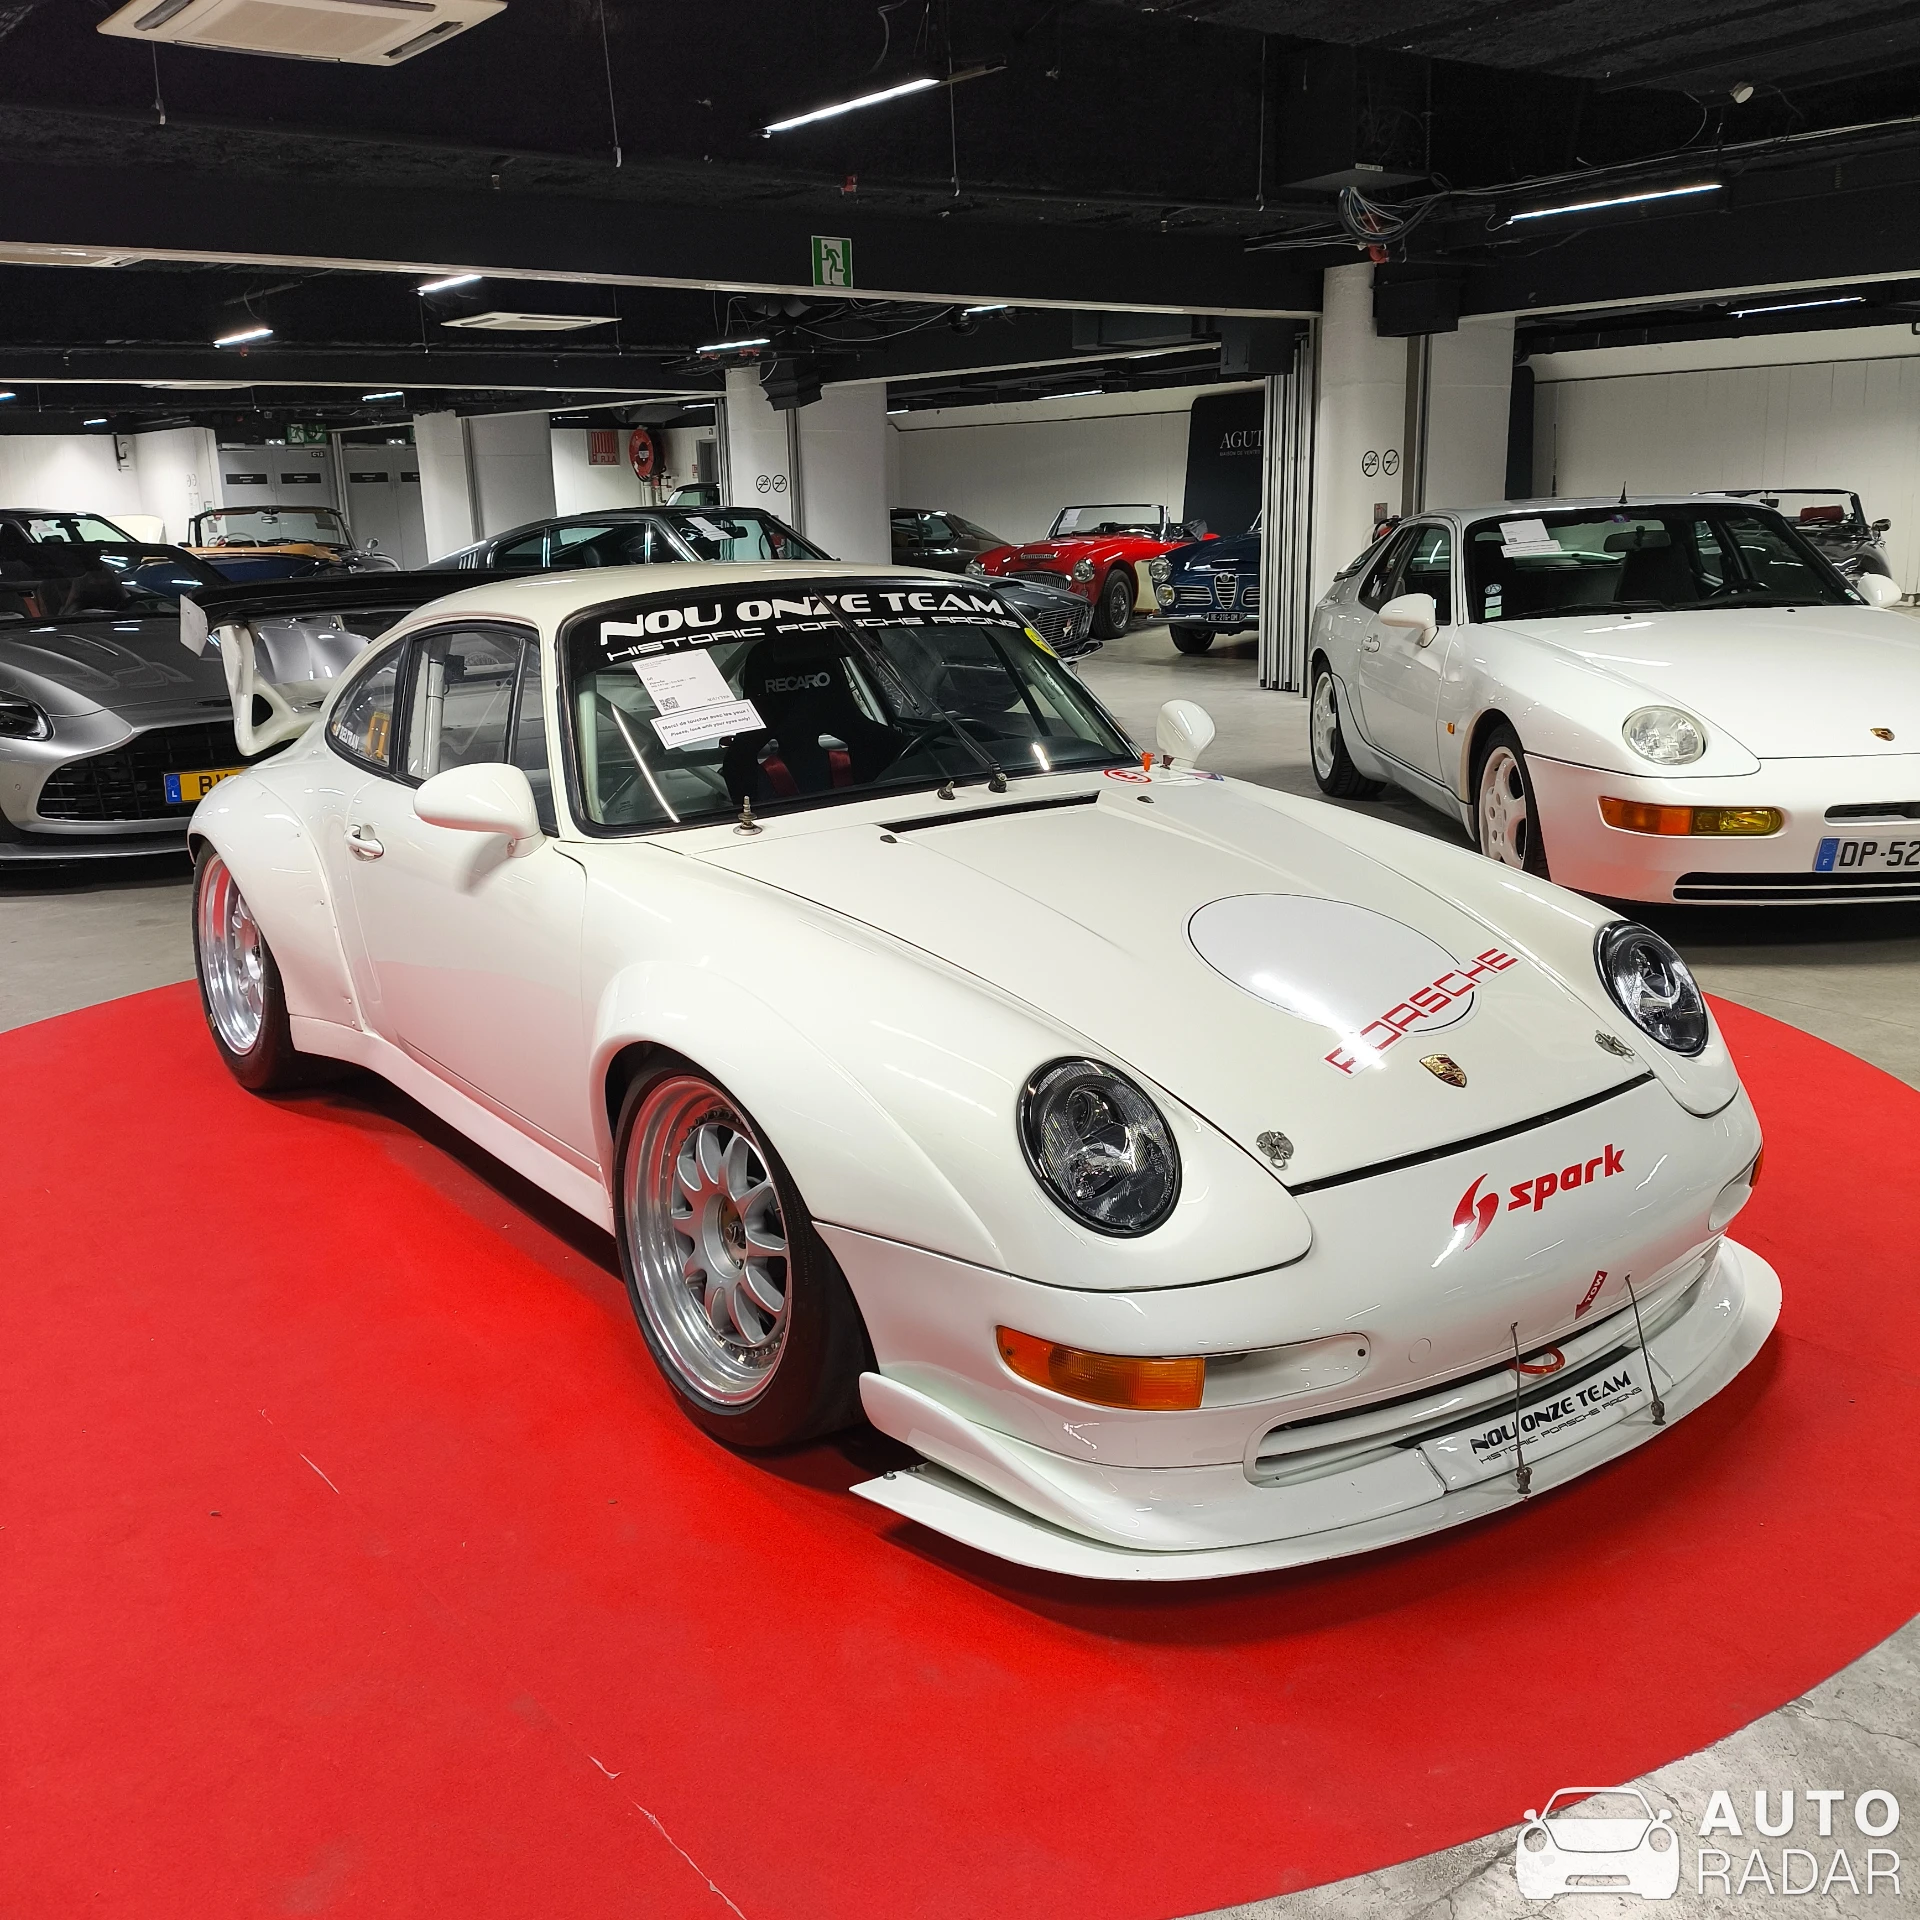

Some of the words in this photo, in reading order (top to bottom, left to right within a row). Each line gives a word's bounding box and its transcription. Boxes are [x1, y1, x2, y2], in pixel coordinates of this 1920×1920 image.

[600, 604, 723, 646] NOU
[736, 594, 872, 622] ONZE
[879, 592, 1004, 615] TEAM
[606, 627, 766, 662] HISTORIC
[931, 616, 1021, 629] RACING
[765, 672, 831, 693] RECARO
[171, 790, 178, 798] L
[1822, 858, 1830, 866] F
[1839, 841, 1920, 867] DP-52
[1324, 947, 1519, 1075] PORSCHE
[1507, 1143, 1625, 1212] spark
[1585, 1274, 1604, 1303] TOW
[1470, 1421, 1517, 1454] NOU
[1520, 1396, 1576, 1433] ONZE
[1576, 1370, 1632, 1407] TEAM
[1479, 1435, 1539, 1465] HISTORIC
[1540, 1407, 1601, 1438] PORSCHE
[1601, 1386, 1643, 1411] RACING
